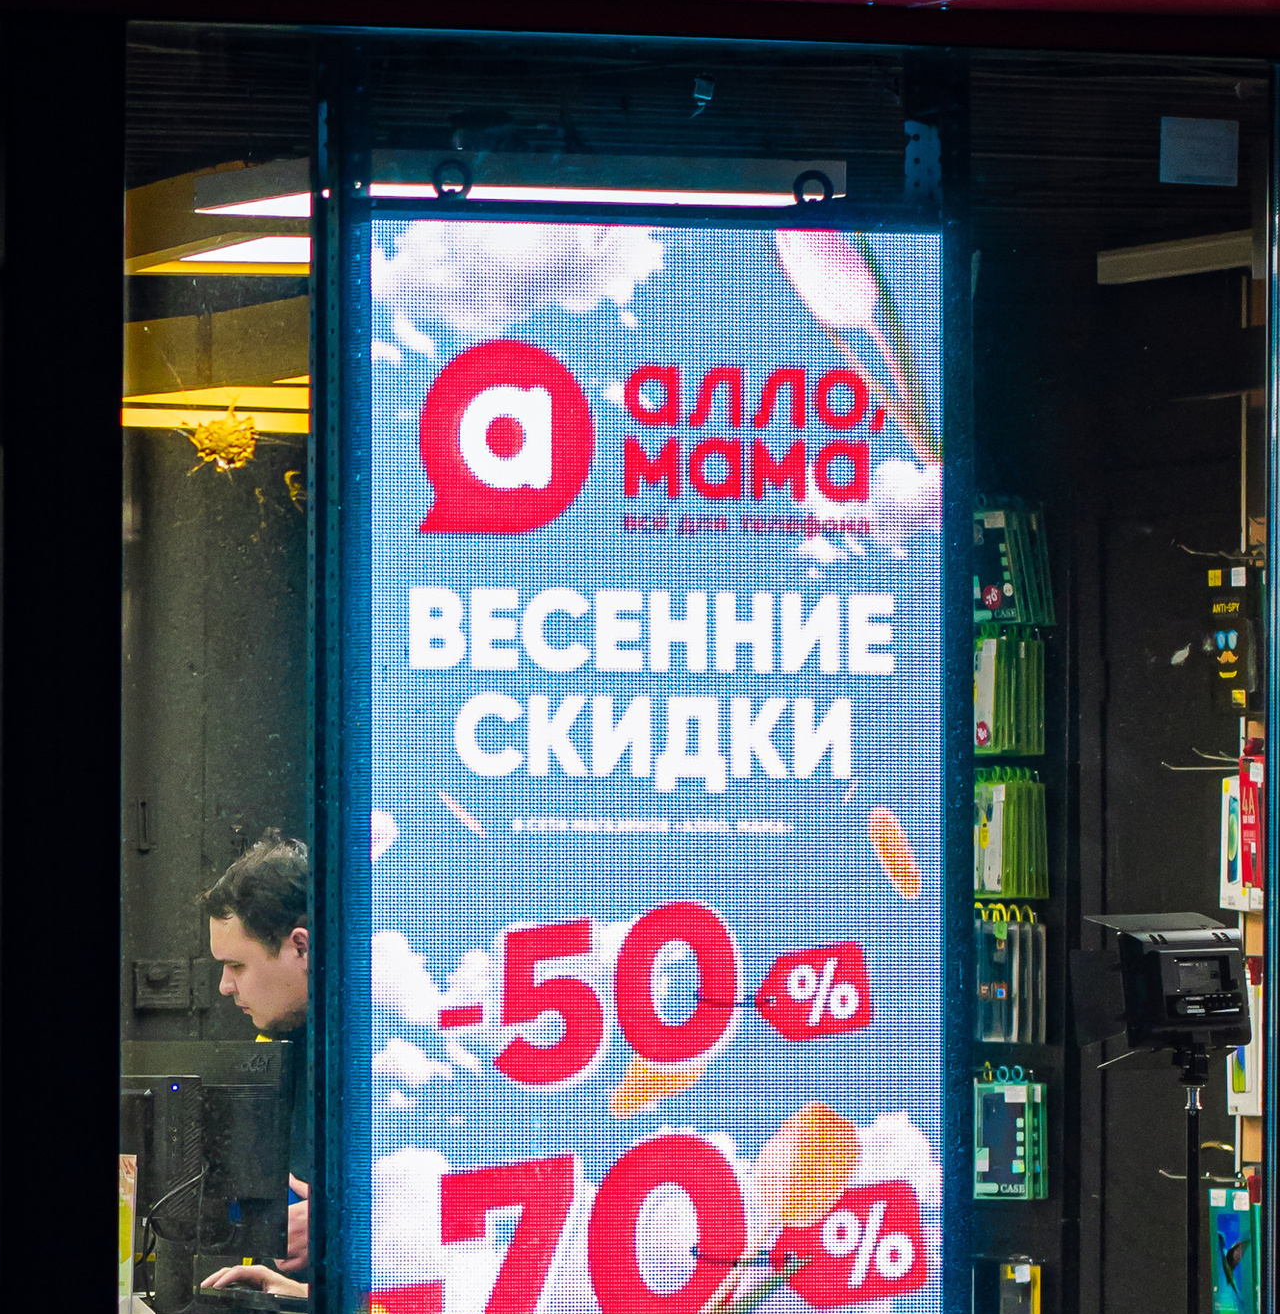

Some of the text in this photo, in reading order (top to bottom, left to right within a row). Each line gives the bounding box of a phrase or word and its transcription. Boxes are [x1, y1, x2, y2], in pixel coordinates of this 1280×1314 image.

[623, 364, 885, 434] алло,
[623, 435, 870, 502] мама
[407, 586, 896, 675] ВЕСЕННИЕ
[994, 607, 1017, 618] CASE
[453, 692, 854, 792] СКИДКИ
[1000, 1183, 1026, 1193] CASE
